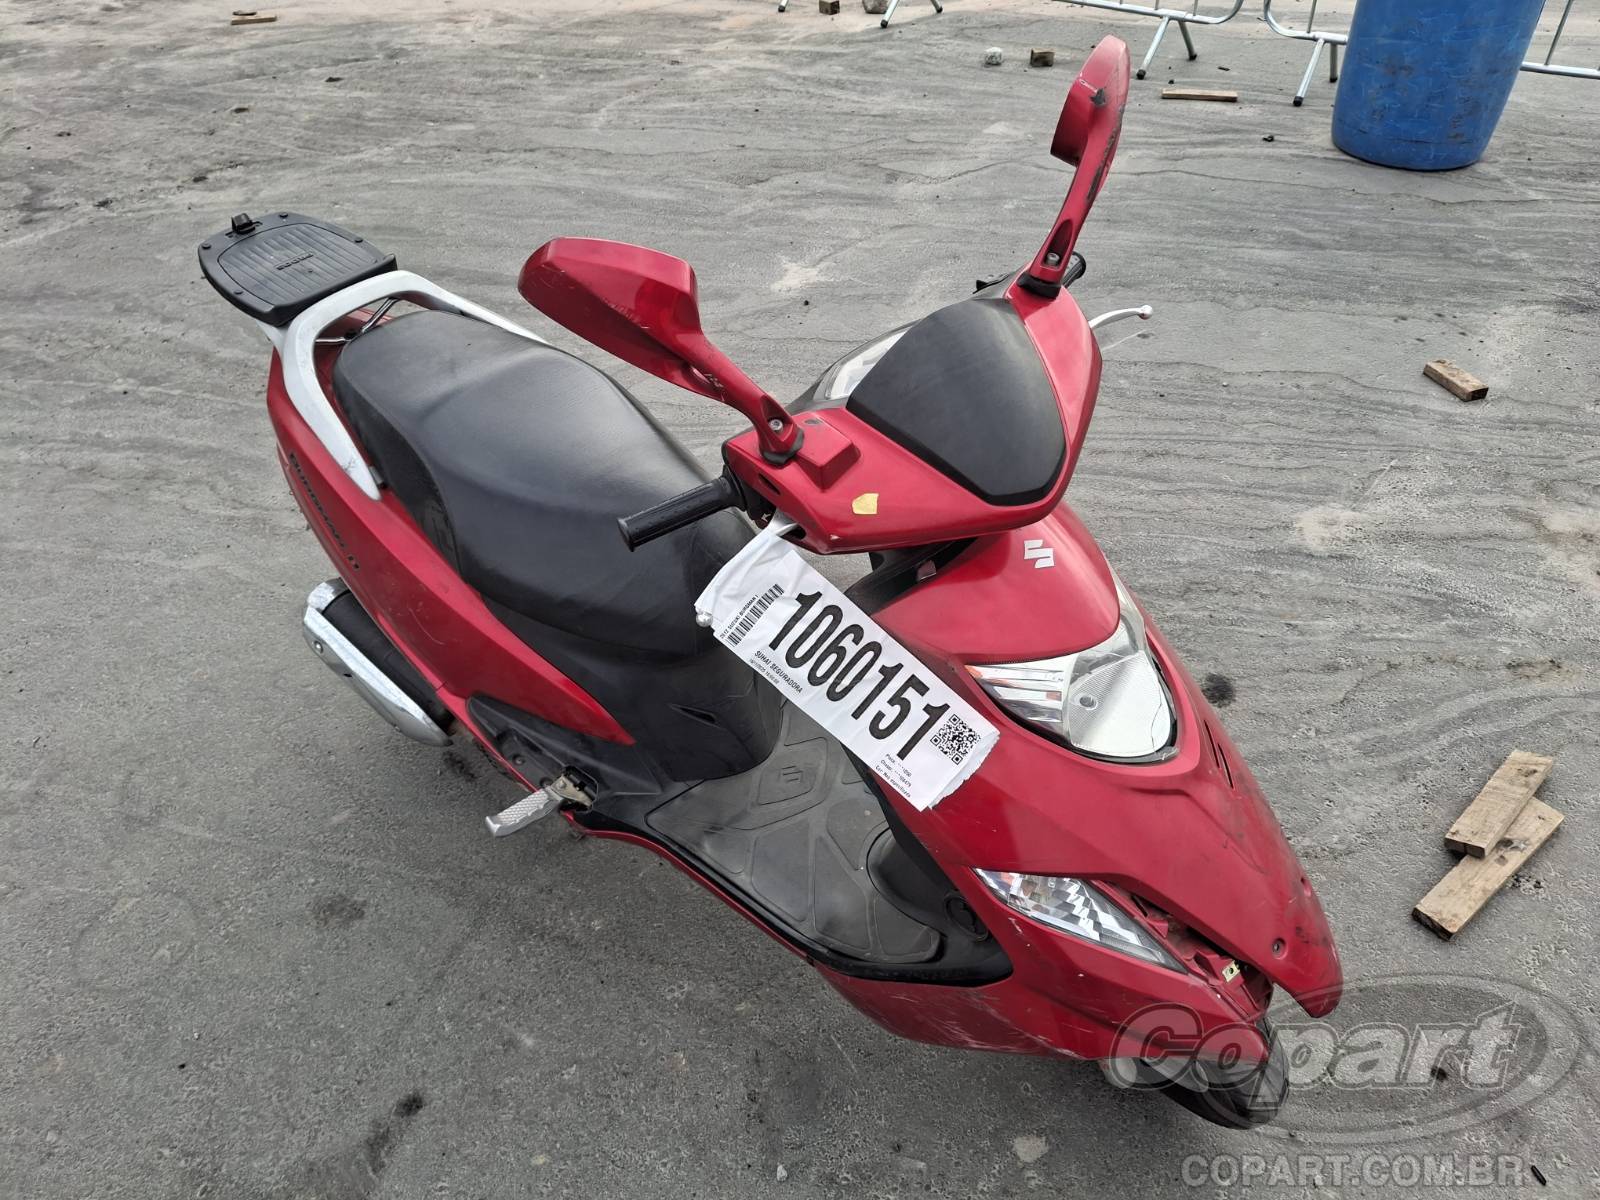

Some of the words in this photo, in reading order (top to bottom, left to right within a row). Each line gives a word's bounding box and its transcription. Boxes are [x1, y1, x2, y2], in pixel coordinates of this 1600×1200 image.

[755, 650, 770, 665] SUHAI
[769, 663, 803, 693] SEGURADORA
[768, 591, 951, 761] 1060151
